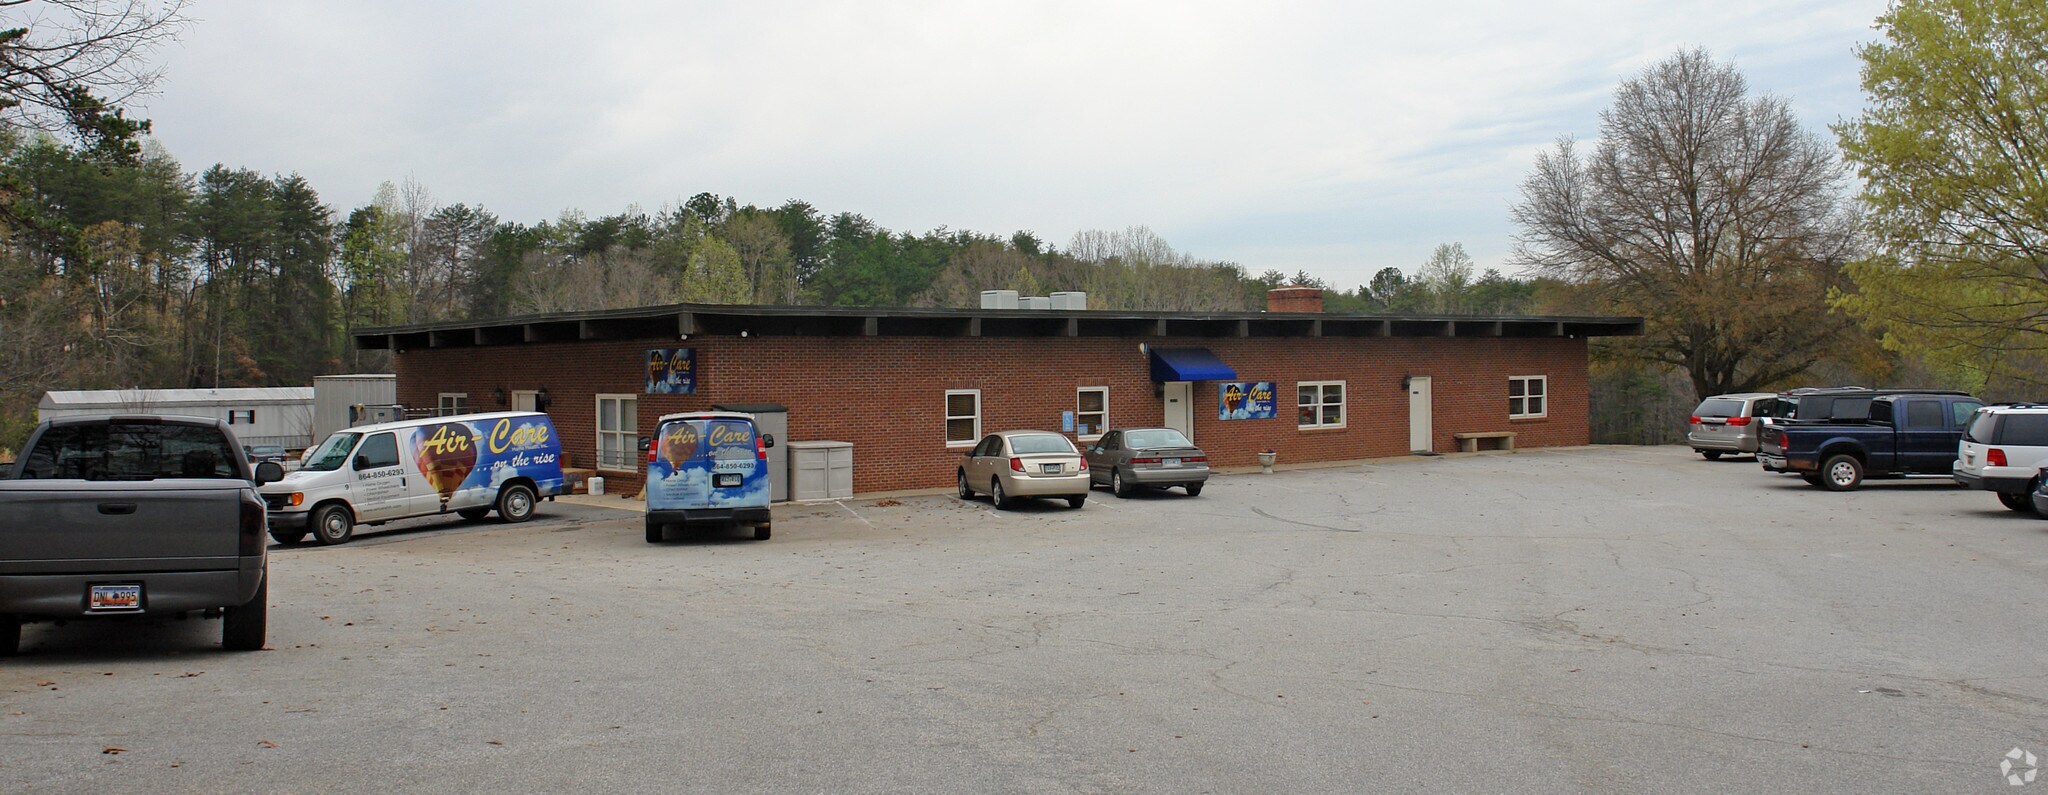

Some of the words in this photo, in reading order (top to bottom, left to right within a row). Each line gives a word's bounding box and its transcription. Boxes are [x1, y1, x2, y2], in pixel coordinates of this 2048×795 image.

[512, 452, 529, 467] the
[533, 453, 555, 465] rise
[358, 469, 404, 480] 864-850-6293
[121, 591, 137, 602] 995
